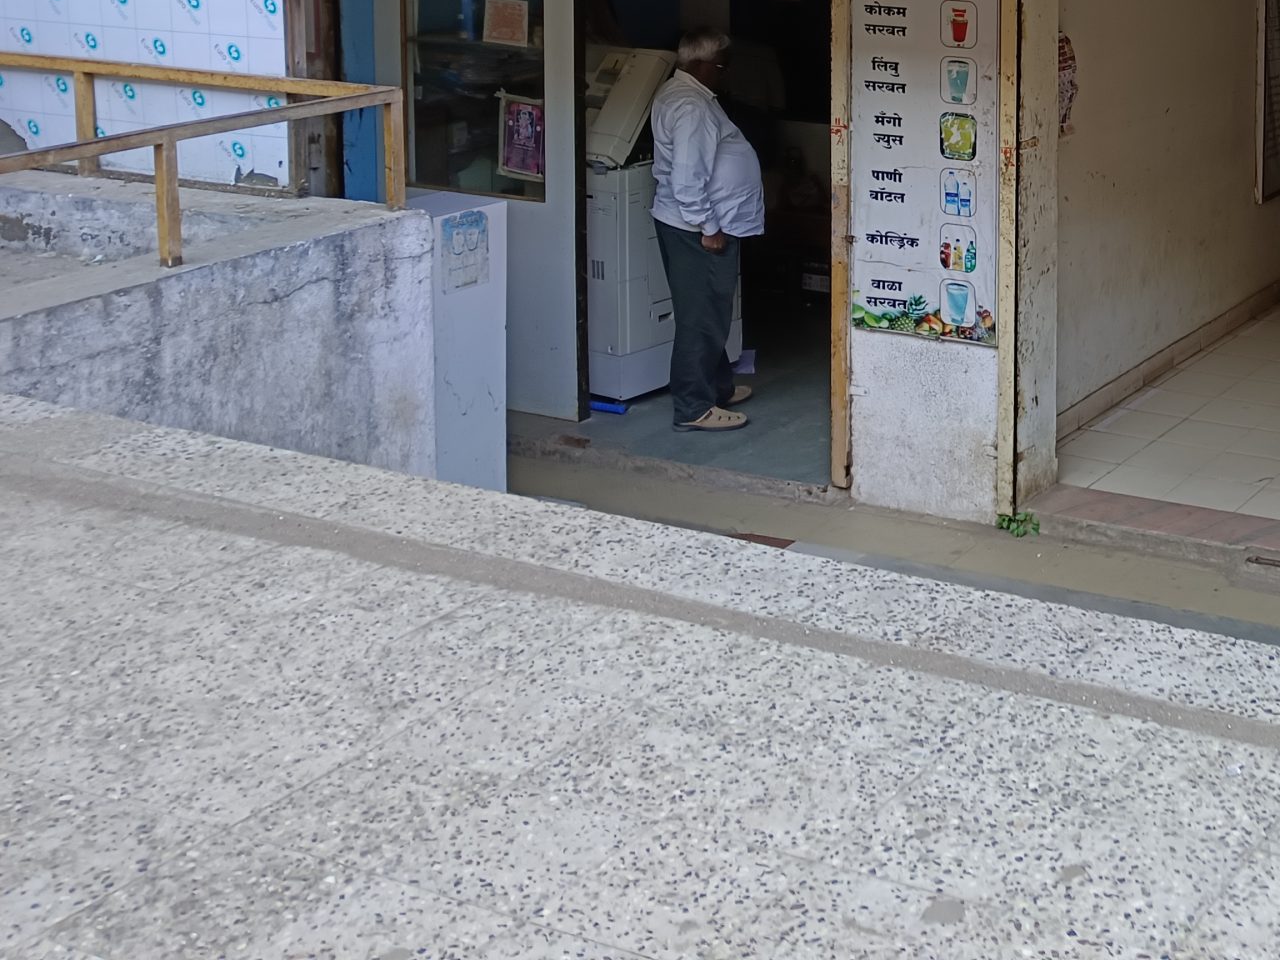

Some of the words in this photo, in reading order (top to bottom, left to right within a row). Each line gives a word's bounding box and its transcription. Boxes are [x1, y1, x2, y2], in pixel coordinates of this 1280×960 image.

[864, 1, 907, 17] कोकम
[864, 23, 907, 37] सरबत
[872, 56, 899, 77] लिंबु
[864, 80, 906, 94] सरबत
[873, 132, 904, 149] ज्युस
[872, 168, 903, 183] पाणी
[869, 188, 905, 203] बॉटल
[871, 278, 903, 291] वाळा
